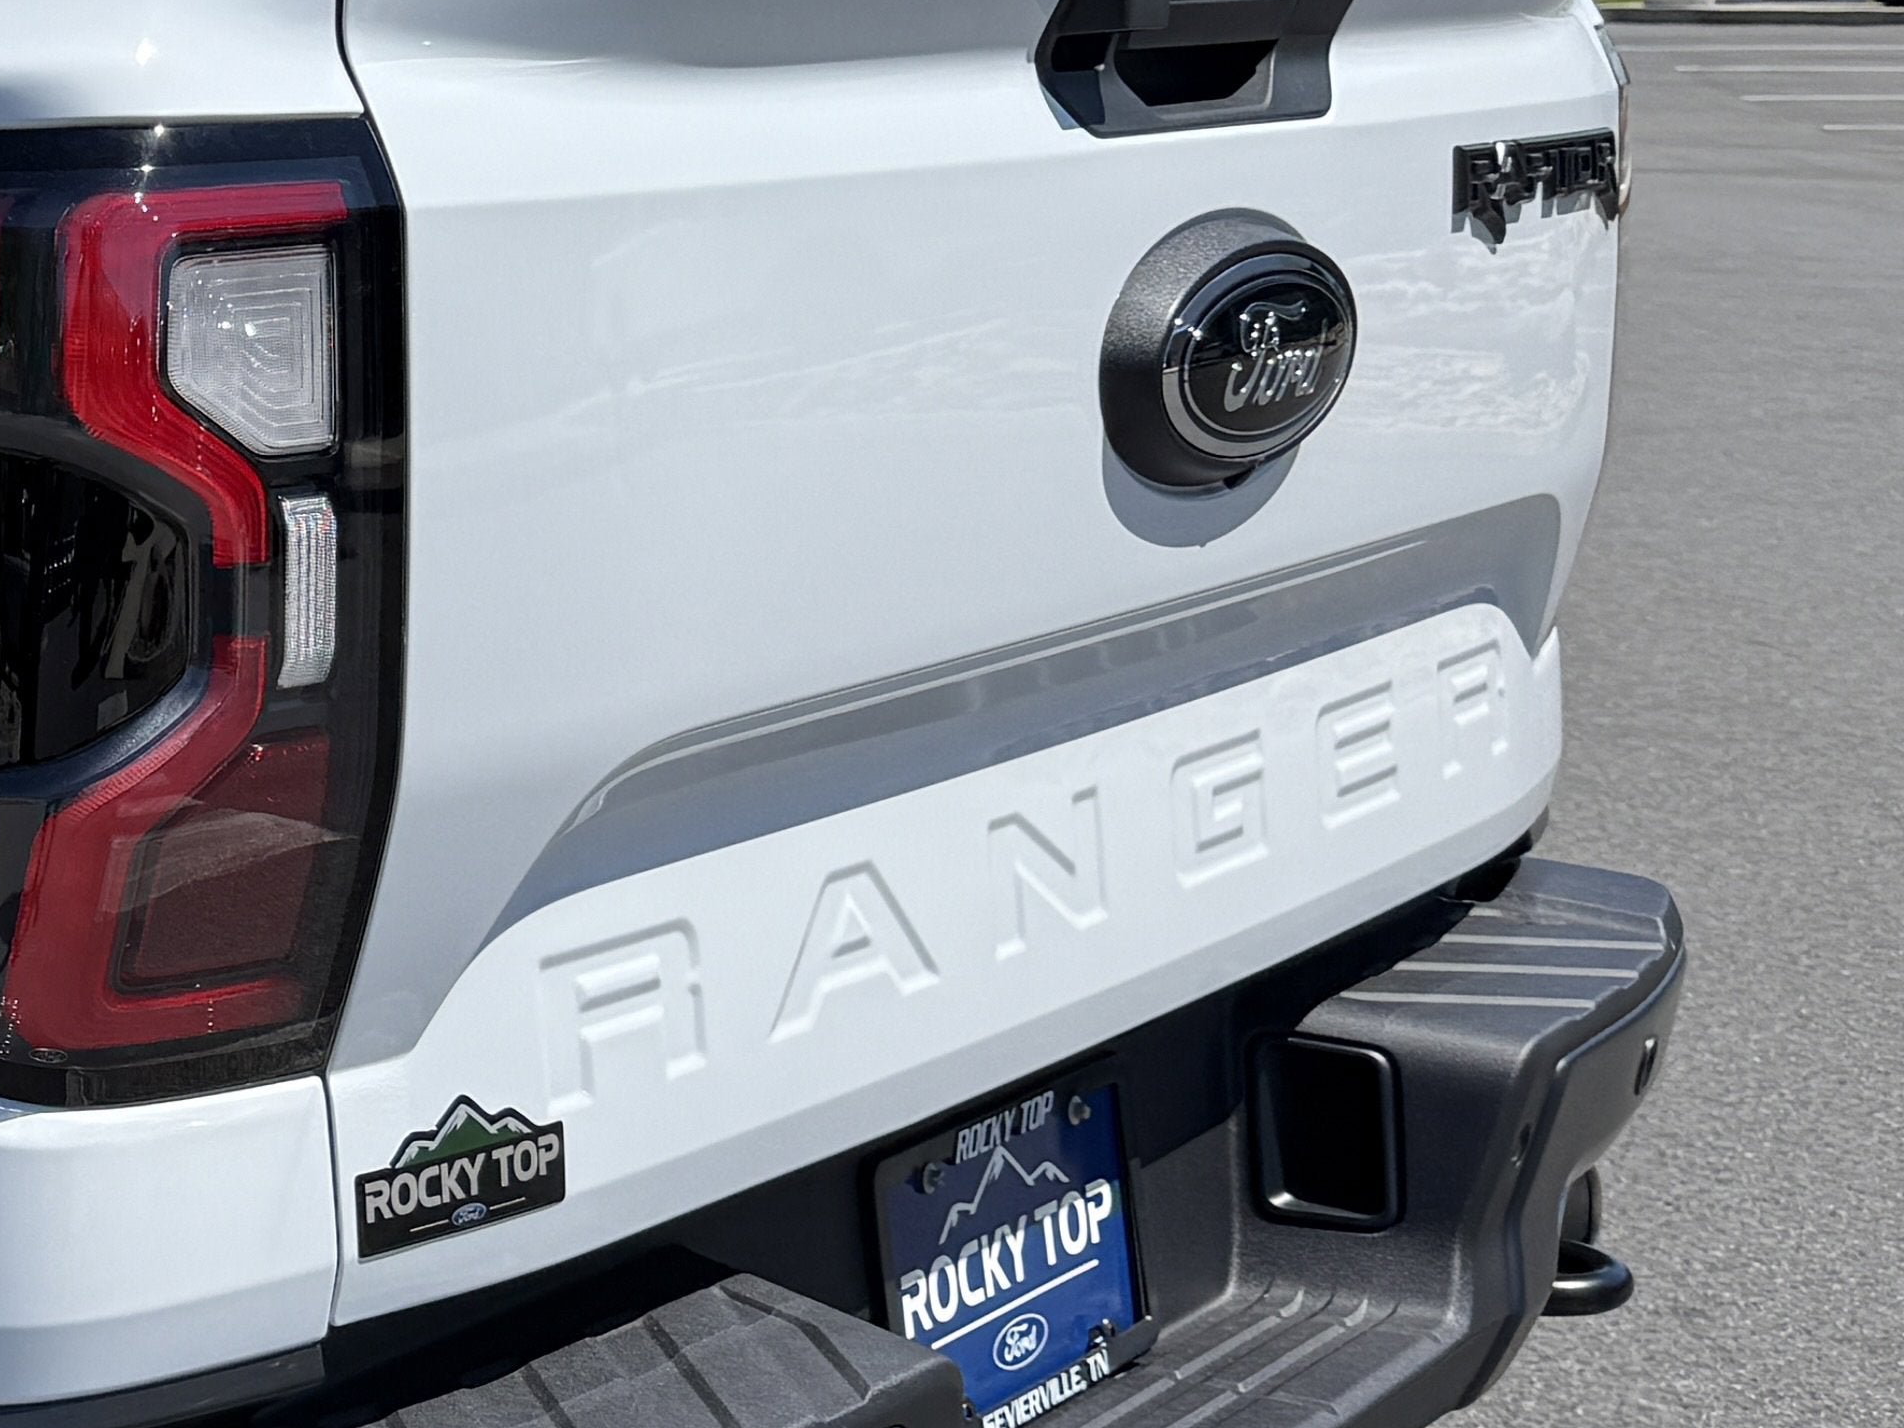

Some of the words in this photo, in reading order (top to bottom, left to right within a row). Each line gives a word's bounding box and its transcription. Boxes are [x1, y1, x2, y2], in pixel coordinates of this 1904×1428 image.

[1453, 127, 1619, 244] RAPTOR
[1224, 299, 1329, 413] Ford
[538, 638, 1508, 1118] RANGER
[955, 1108, 1016, 1164] ROCKY
[1020, 1090, 1054, 1134] TOP
[365, 1153, 485, 1223] ROCKY
[492, 1133, 559, 1187] TOP
[453, 1205, 485, 1225] Ford
[900, 1214, 1028, 1340] ROCKY
[1034, 1178, 1112, 1266] TOP
[1004, 1323, 1037, 1362] Ford
[1088, 1349, 1111, 1381] TN
